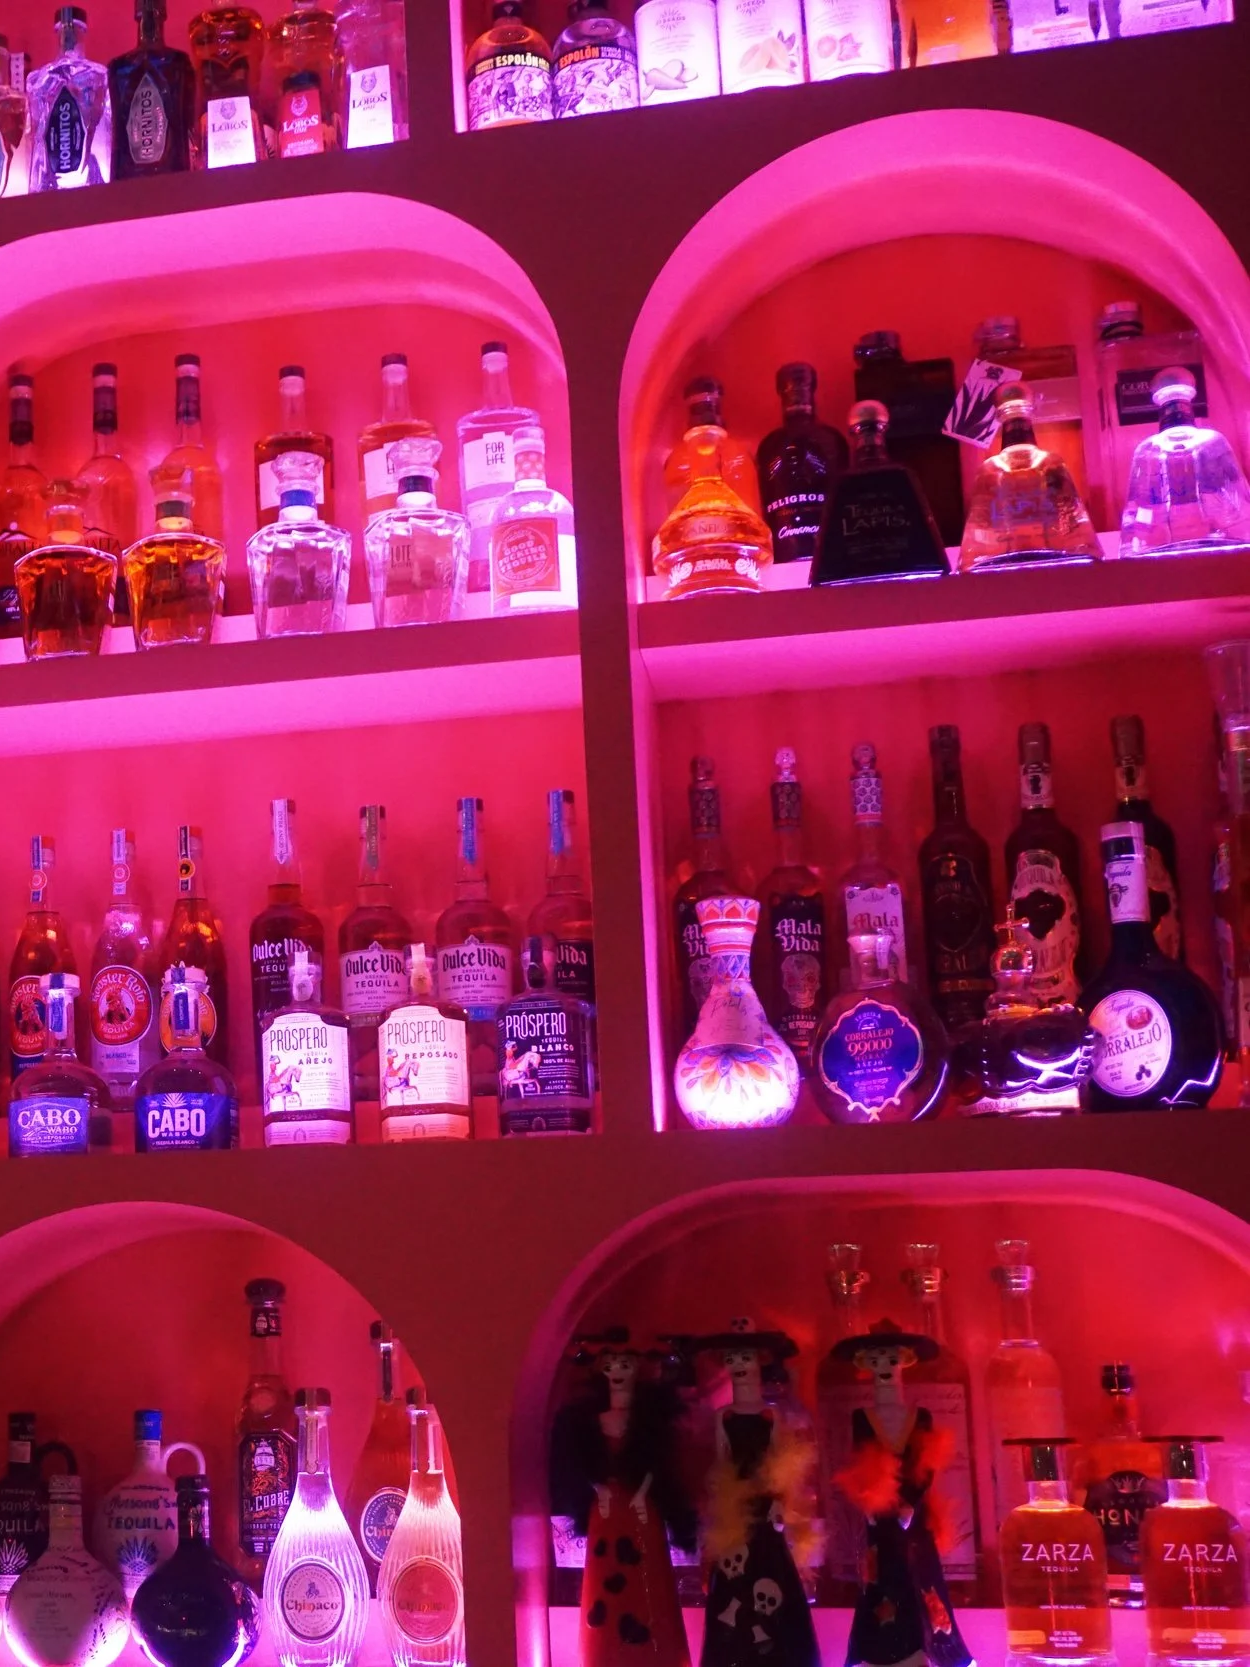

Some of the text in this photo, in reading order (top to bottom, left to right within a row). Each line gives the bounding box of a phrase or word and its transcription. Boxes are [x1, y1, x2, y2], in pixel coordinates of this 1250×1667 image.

[352, 92, 388, 110] LOBOS
[211, 120, 248, 133] LOBOS
[283, 115, 319, 133] LOBOS
[59, 101, 72, 171] HORNITOS
[485, 441, 505, 454] FOR
[486, 454, 506, 466] LIFE
[767, 493, 825, 513] PELIGROS
[777, 525, 820, 540] Cinnamo
[505, 540, 535, 556] GOOD
[501, 553, 548, 573] TEQUILA
[775, 918, 822, 938] Mala
[853, 911, 899, 929] Mala
[252, 939, 282, 962] Dulce
[780, 935, 820, 952] Vida
[345, 956, 377, 977] Dulce
[442, 947, 506, 972] Dulce Vida
[260, 965, 286, 973] TEQU
[354, 980, 399, 989] TEQUILA
[451, 973, 497, 983] TEQUILA
[11, 982, 39, 1012] ooster
[387, 1019, 447, 1046] PRÓSPERO
[505, 1011, 567, 1041] PRÓSPERO
[788, 1021, 816, 1030] REPOSAD
[14, 1031, 47, 1044] TEQUIL
[270, 1026, 328, 1053] PRÓSPERO
[844, 1028, 894, 1042] CORRALEJO
[1102, 1022, 1163, 1059] ORRALEJO
[404, 1050, 459, 1061] REPOSADO
[531, 1043, 575, 1053] BLANCO
[848, 1038, 893, 1056] 99000
[298, 1057, 334, 1066] AÑEJO
[16, 1108, 82, 1130] CABO
[147, 1108, 206, 1138] CABO
[45, 1126, 78, 1135] WABO
[255, 1489, 290, 1511] COBRE
[107, 1516, 176, 1531] TEQUILA
[364, 1524, 392, 1539] Chin
[1021, 1543, 1095, 1562] ZARZA
[1163, 1543, 1238, 1563] ZARZA
[1040, 1565, 1079, 1573] TEQUILA
[1183, 1565, 1223, 1574] TEQUILA
[286, 1598, 341, 1613] Chinaco
